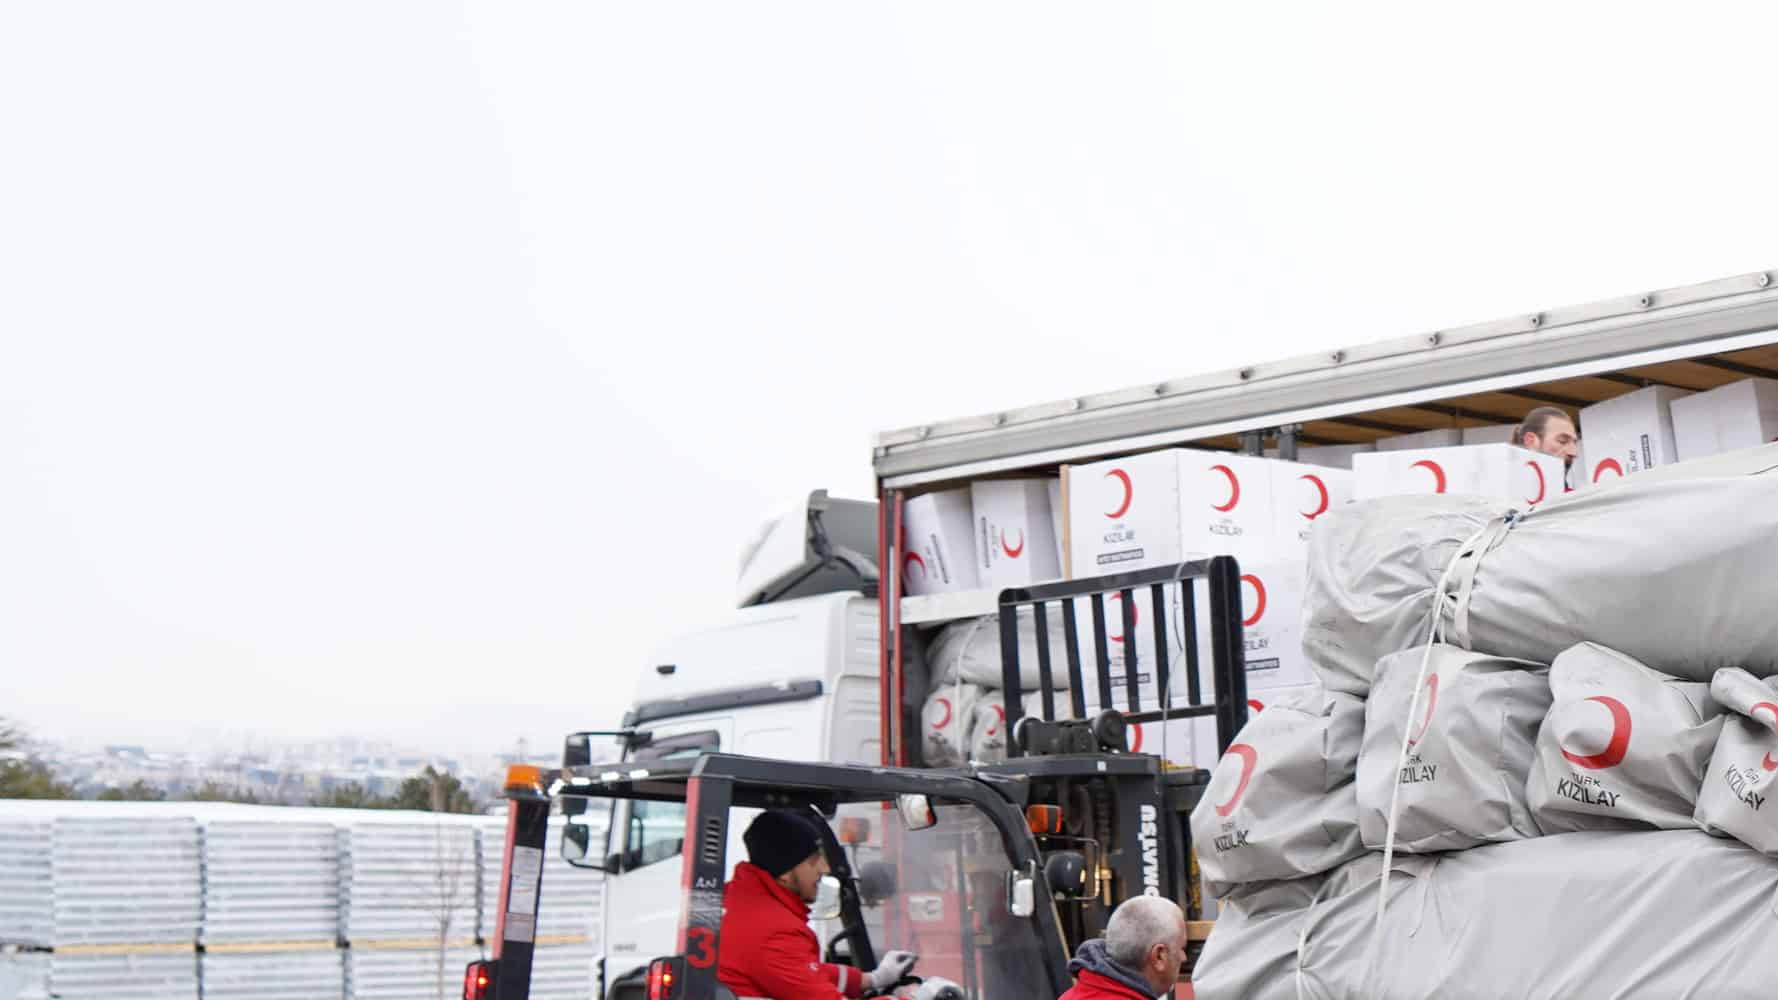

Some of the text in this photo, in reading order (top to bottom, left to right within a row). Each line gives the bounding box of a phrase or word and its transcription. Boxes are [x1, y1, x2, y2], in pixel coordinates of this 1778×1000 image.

[1557, 776, 1621, 807] KIZILAY
[1724, 763, 1766, 811] KIZILAY
[1137, 804, 1160, 896] OMATSU
[687, 926, 716, 969] 3
